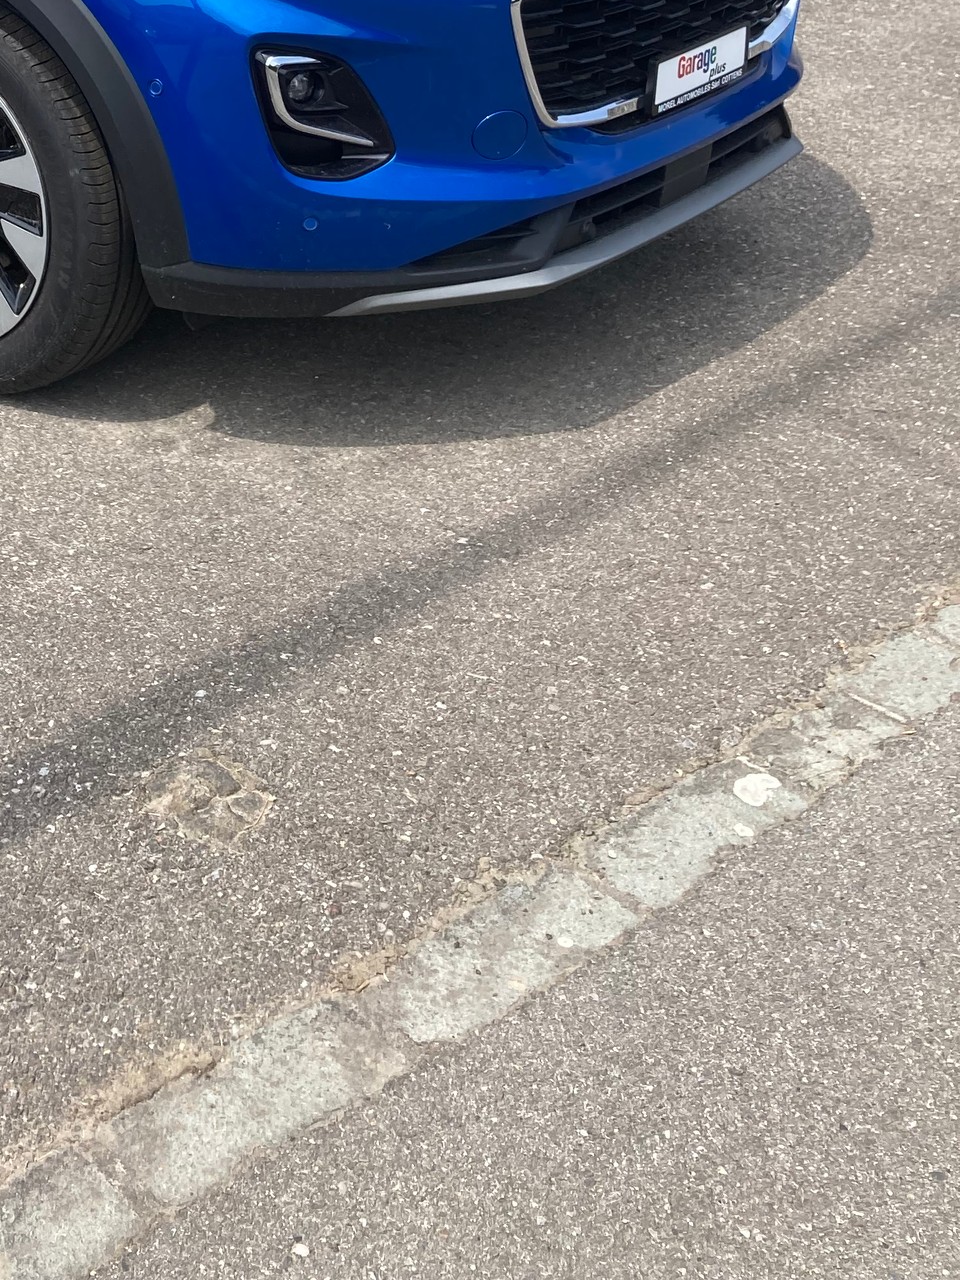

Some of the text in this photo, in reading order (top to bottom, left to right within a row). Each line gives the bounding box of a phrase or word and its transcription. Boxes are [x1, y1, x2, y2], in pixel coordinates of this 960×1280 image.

[677, 46, 717, 79] Garage
[708, 62, 727, 81] plus
[657, 99, 677, 113] MOREL
[676, 83, 711, 105] AUTOMOBILES
[721, 68, 743, 84] COTTENS
